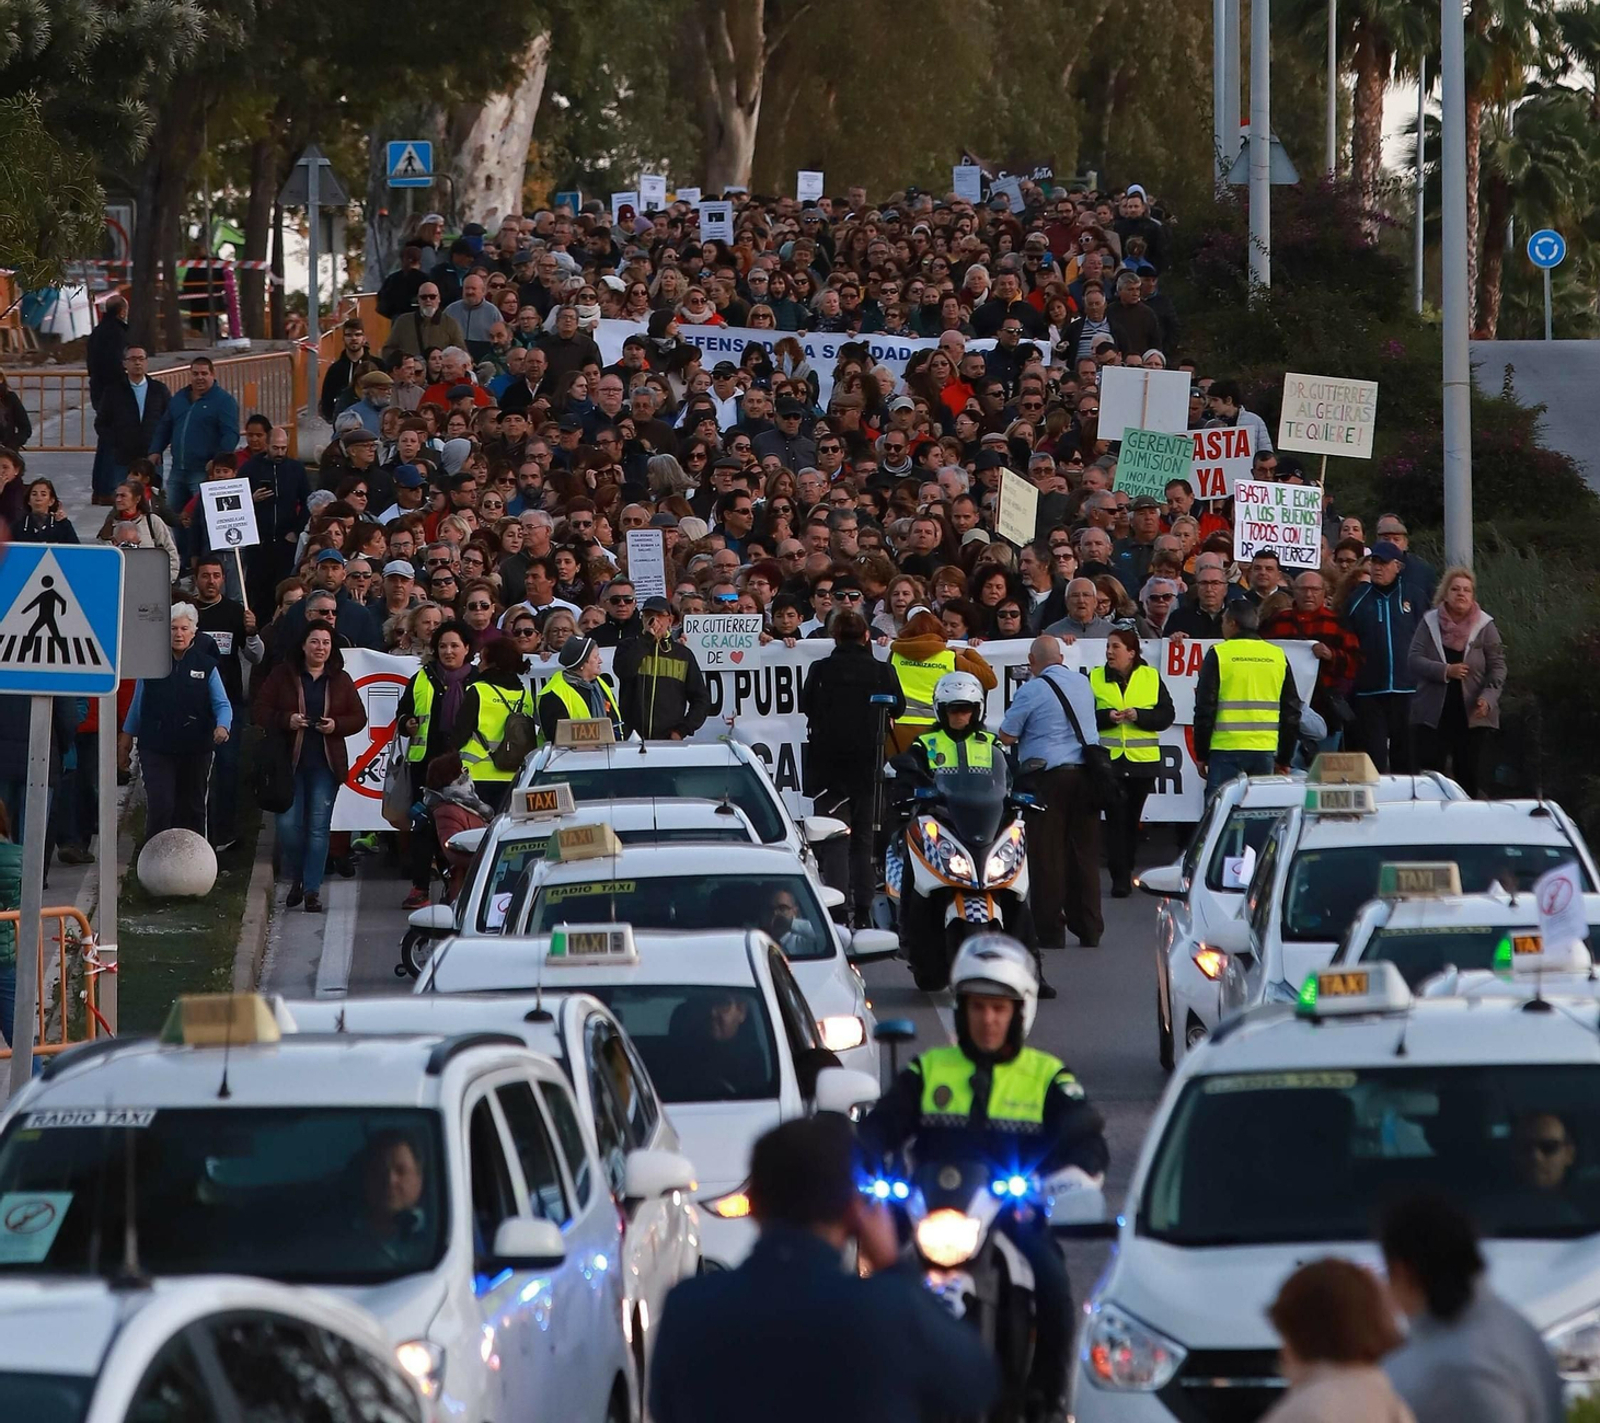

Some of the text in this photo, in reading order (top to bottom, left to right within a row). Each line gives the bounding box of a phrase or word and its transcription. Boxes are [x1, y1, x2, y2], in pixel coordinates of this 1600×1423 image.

[1296, 402, 1374, 423] ALGECIRAS
[1286, 421, 1304, 438] TE
[1127, 431, 1194, 459] GERENTE
[1175, 429, 1251, 462] ASTA
[1123, 449, 1184, 474] DIMISIÓN
[1148, 474, 1157, 486] A
[1196, 467, 1227, 498] YA
[1275, 486, 1288, 507] DE
[1293, 488, 1321, 509] ECHAR
[1244, 504, 1253, 521] A
[1257, 505, 1276, 523] LOS
[1283, 526, 1302, 545] CON
[1305, 527, 1317, 546] EL
[702, 616, 760, 634] GUTIÉRREZ
[701, 634, 753, 649] GRACIAS
[707, 651, 724, 664] DE
[900, 660, 947, 670] ORGANIZACIÓN
[1231, 656, 1275, 664] ORGANIZACIÓN
[572, 724, 599, 741] TAXI
[527, 792, 557, 810] TAXI
[1322, 792, 1350, 808] TAXI
[561, 829, 593, 847] TAXI
[550, 883, 631, 897] RADIO TAXI
[1397, 870, 1434, 892] TAXI
[570, 933, 608, 953] TAXI
[1514, 937, 1543, 953] TA
[1319, 973, 1368, 996] TAXI
[33, 1112, 150, 1126] RADIO TAXI
